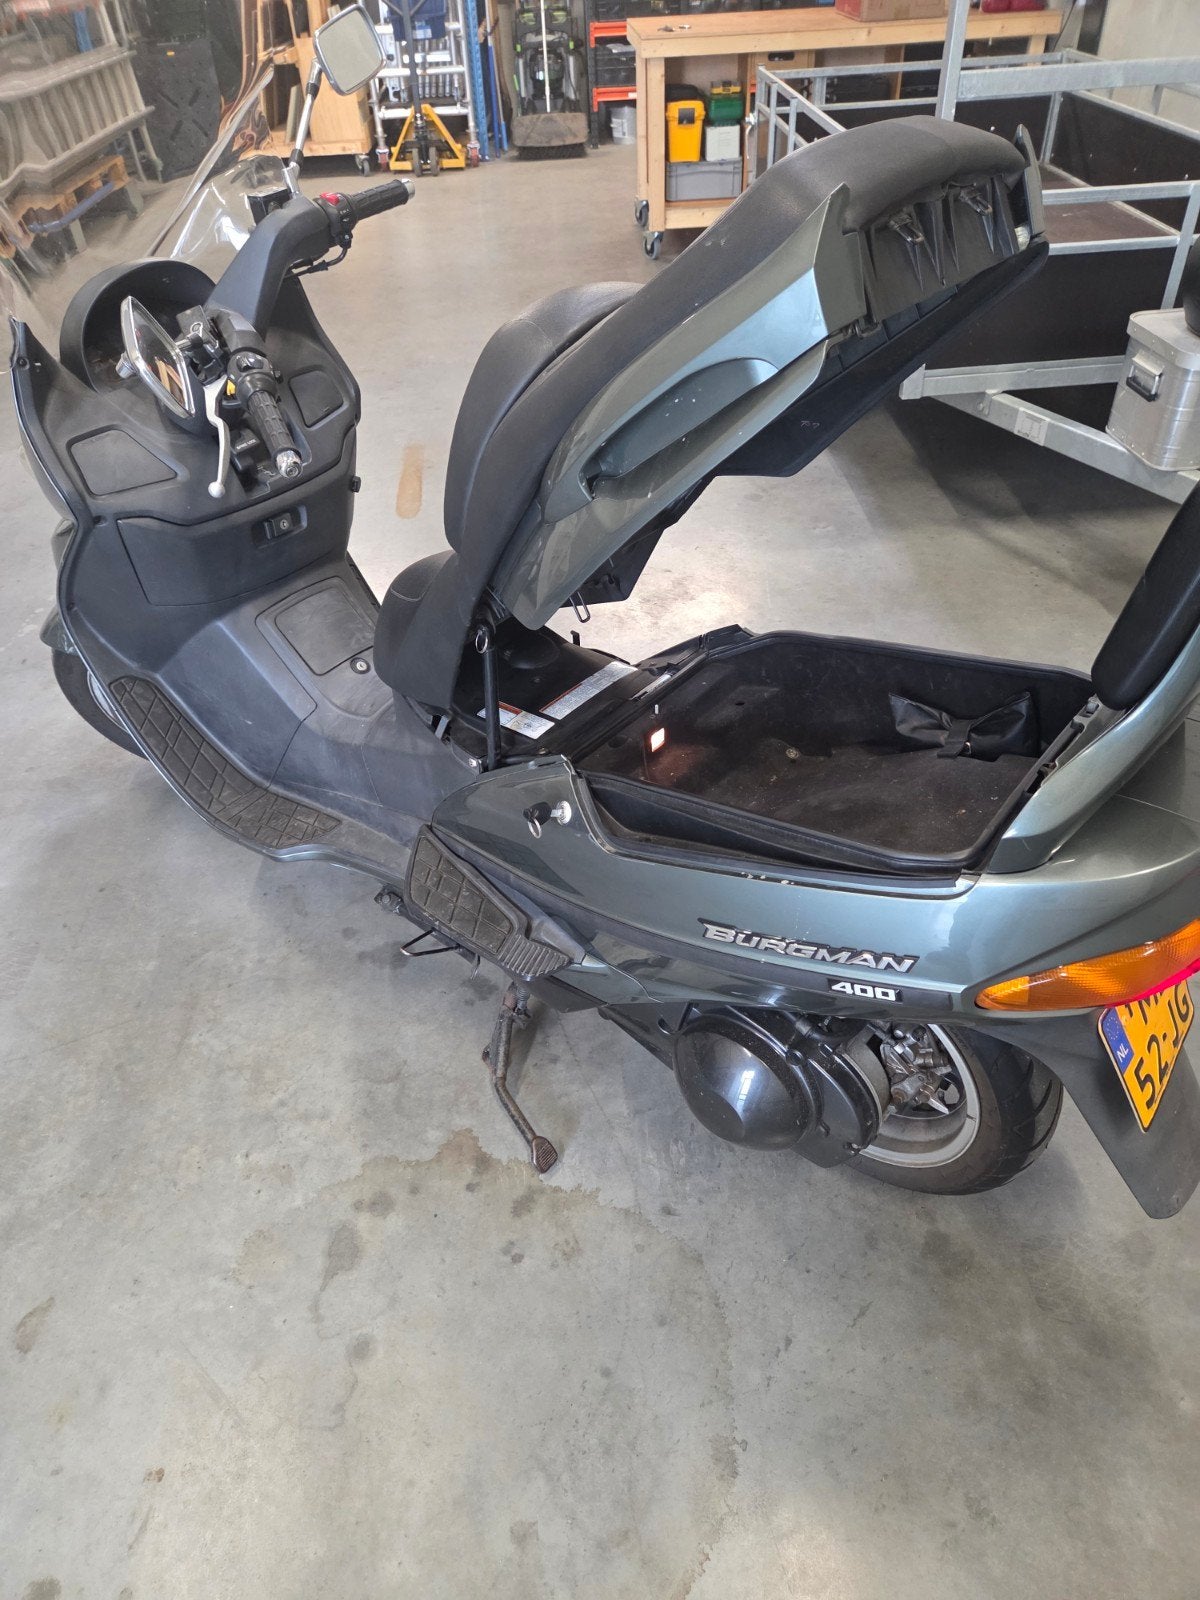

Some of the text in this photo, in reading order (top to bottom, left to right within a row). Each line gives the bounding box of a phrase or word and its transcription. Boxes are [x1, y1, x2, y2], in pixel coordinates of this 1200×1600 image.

[703, 923, 914, 972] BURGMAN
[831, 982, 898, 1001] 400
[1116, 1044, 1129, 1062] NL
